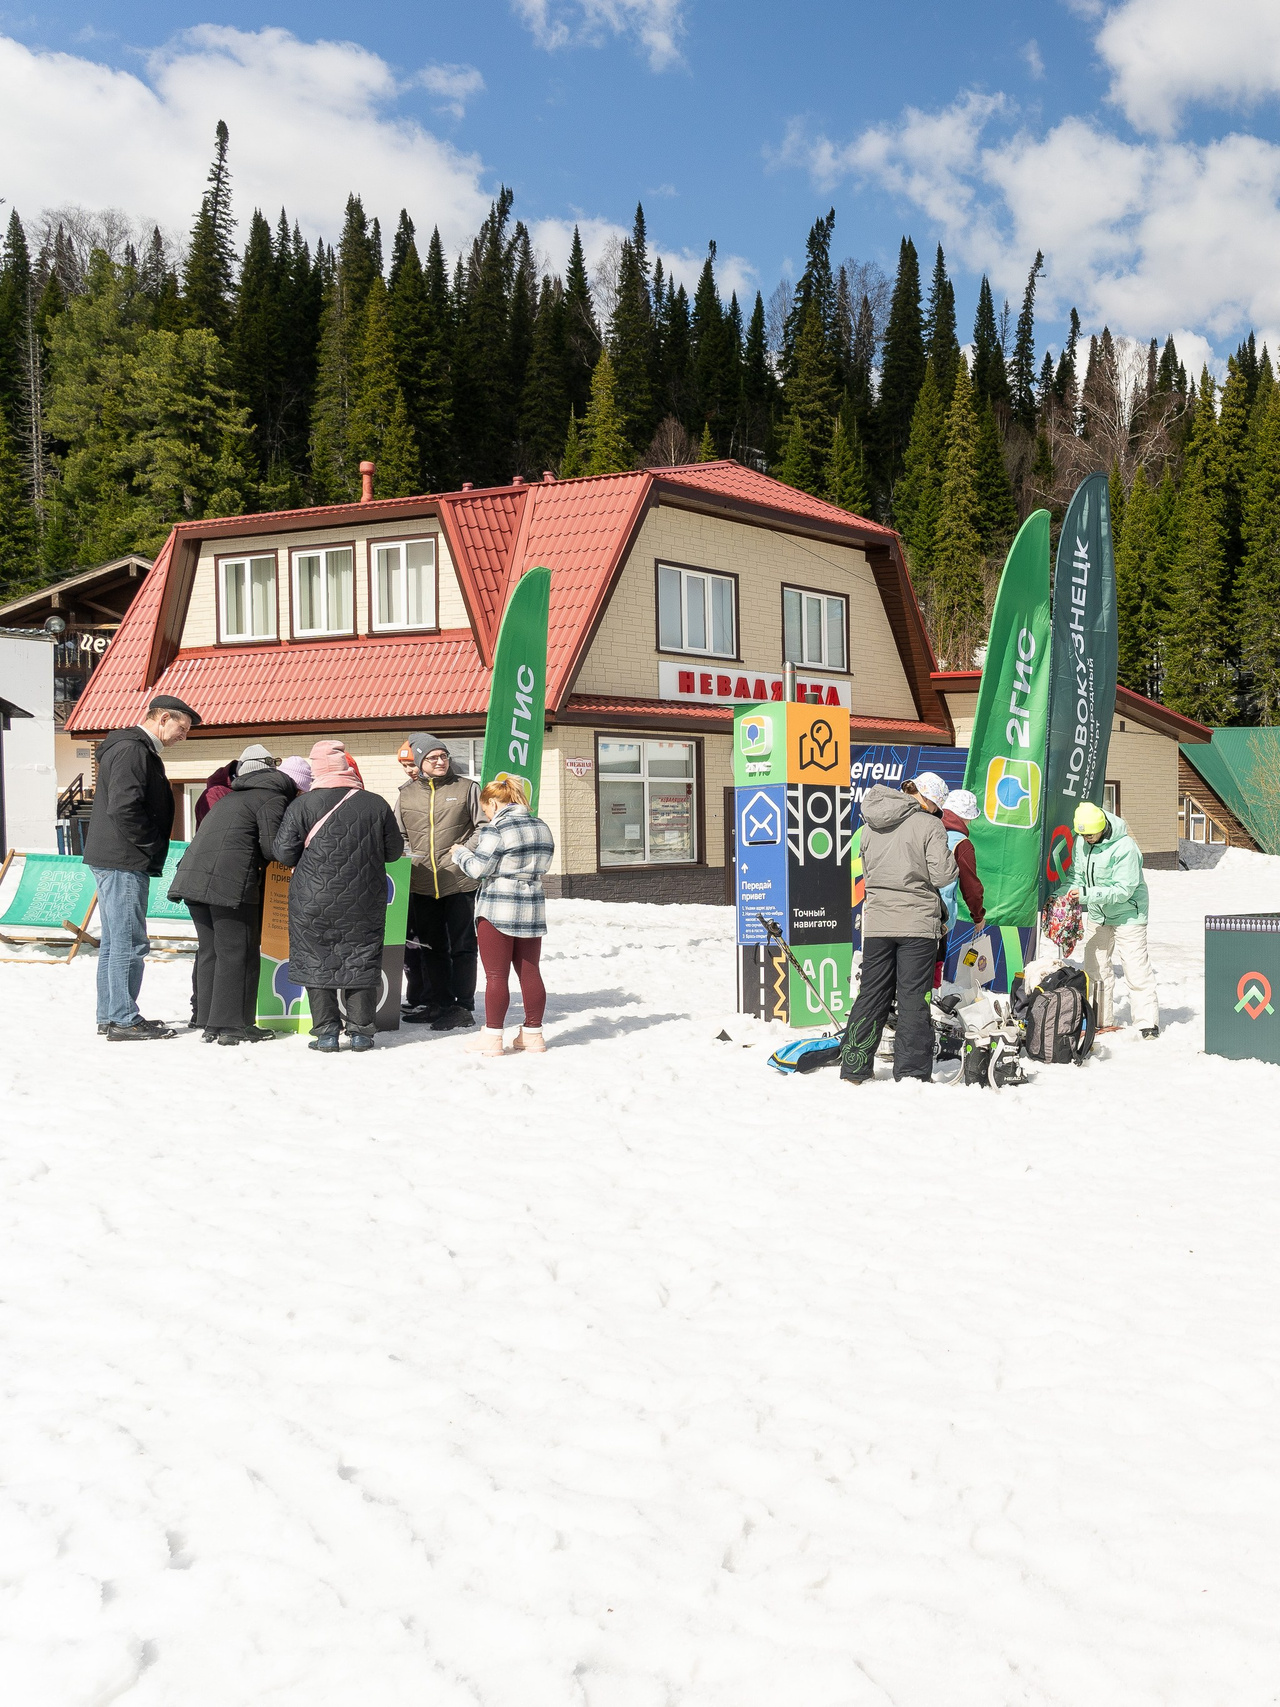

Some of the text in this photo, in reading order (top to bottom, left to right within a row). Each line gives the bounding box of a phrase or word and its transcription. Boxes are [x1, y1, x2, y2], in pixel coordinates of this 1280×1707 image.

[1063, 536, 1090, 797] НОВОКУЗНЕЦК
[1006, 627, 1036, 748] 2ГИС
[508, 664, 535, 766] 2ГИС
[850, 762, 904, 781] егеш
[271, 874, 290, 883] прив
[741, 879, 772, 891] Передай
[741, 892, 766, 902] привет
[793, 907, 825, 918] Точный
[793, 920, 837, 930] навигатор
